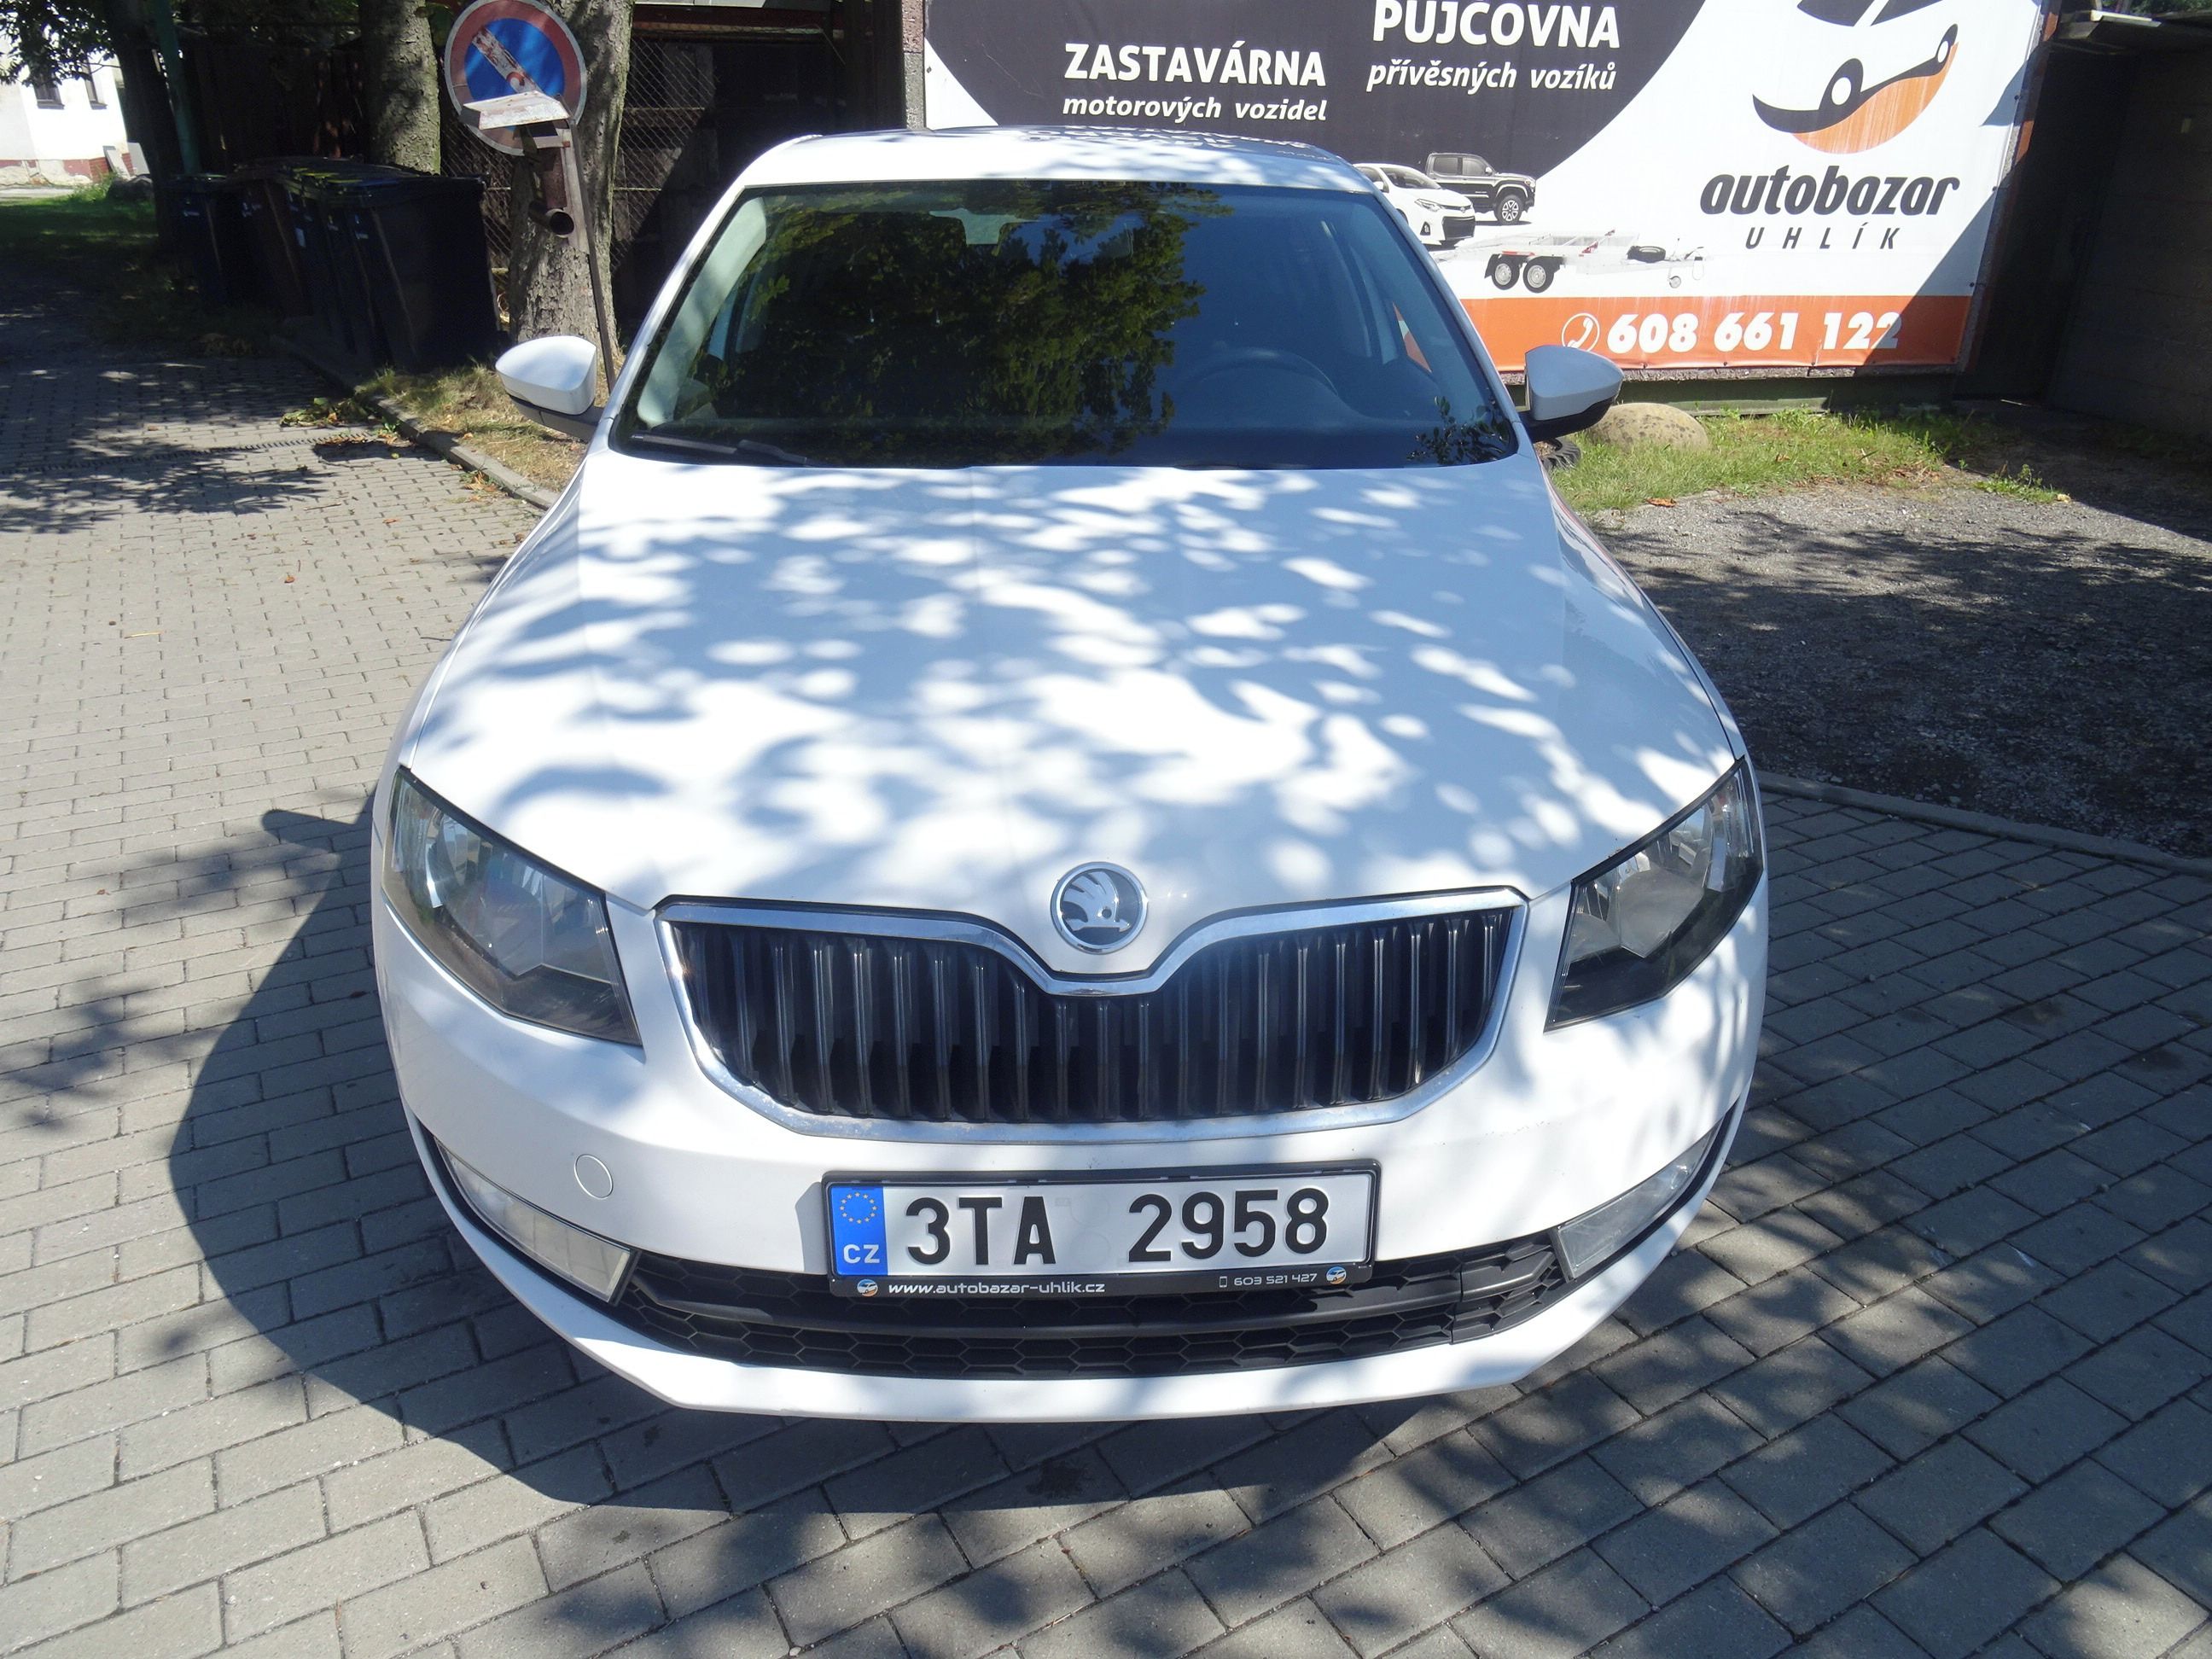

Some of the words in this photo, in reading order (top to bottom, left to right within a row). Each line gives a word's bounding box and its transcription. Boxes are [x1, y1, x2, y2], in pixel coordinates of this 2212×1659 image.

[1064, 40, 1326, 86] ZASTAVÁRNA
[1365, 59, 1517, 95] přívěsných
[1530, 61, 1617, 90] vozíků
[1062, 96, 1222, 123] motorových
[1235, 98, 1327, 121] vozidel
[1700, 165, 1960, 216] autobazar
[1745, 222, 1901, 250] UHLÍK
[1607, 312, 1699, 354] 608
[1714, 311, 1799, 352] 661
[1821, 311, 1901, 351] 122
[905, 1196, 1057, 1266] 3TA
[1128, 1187, 1330, 1263] 2958
[843, 1243, 880, 1264] CZ
[888, 1281, 1105, 1294] www.autobazar-uhlik.cz
[1233, 1276, 1262, 1286] 603
[1266, 1274, 1288, 1284] 521
[1291, 1272, 1318, 1283] 427
